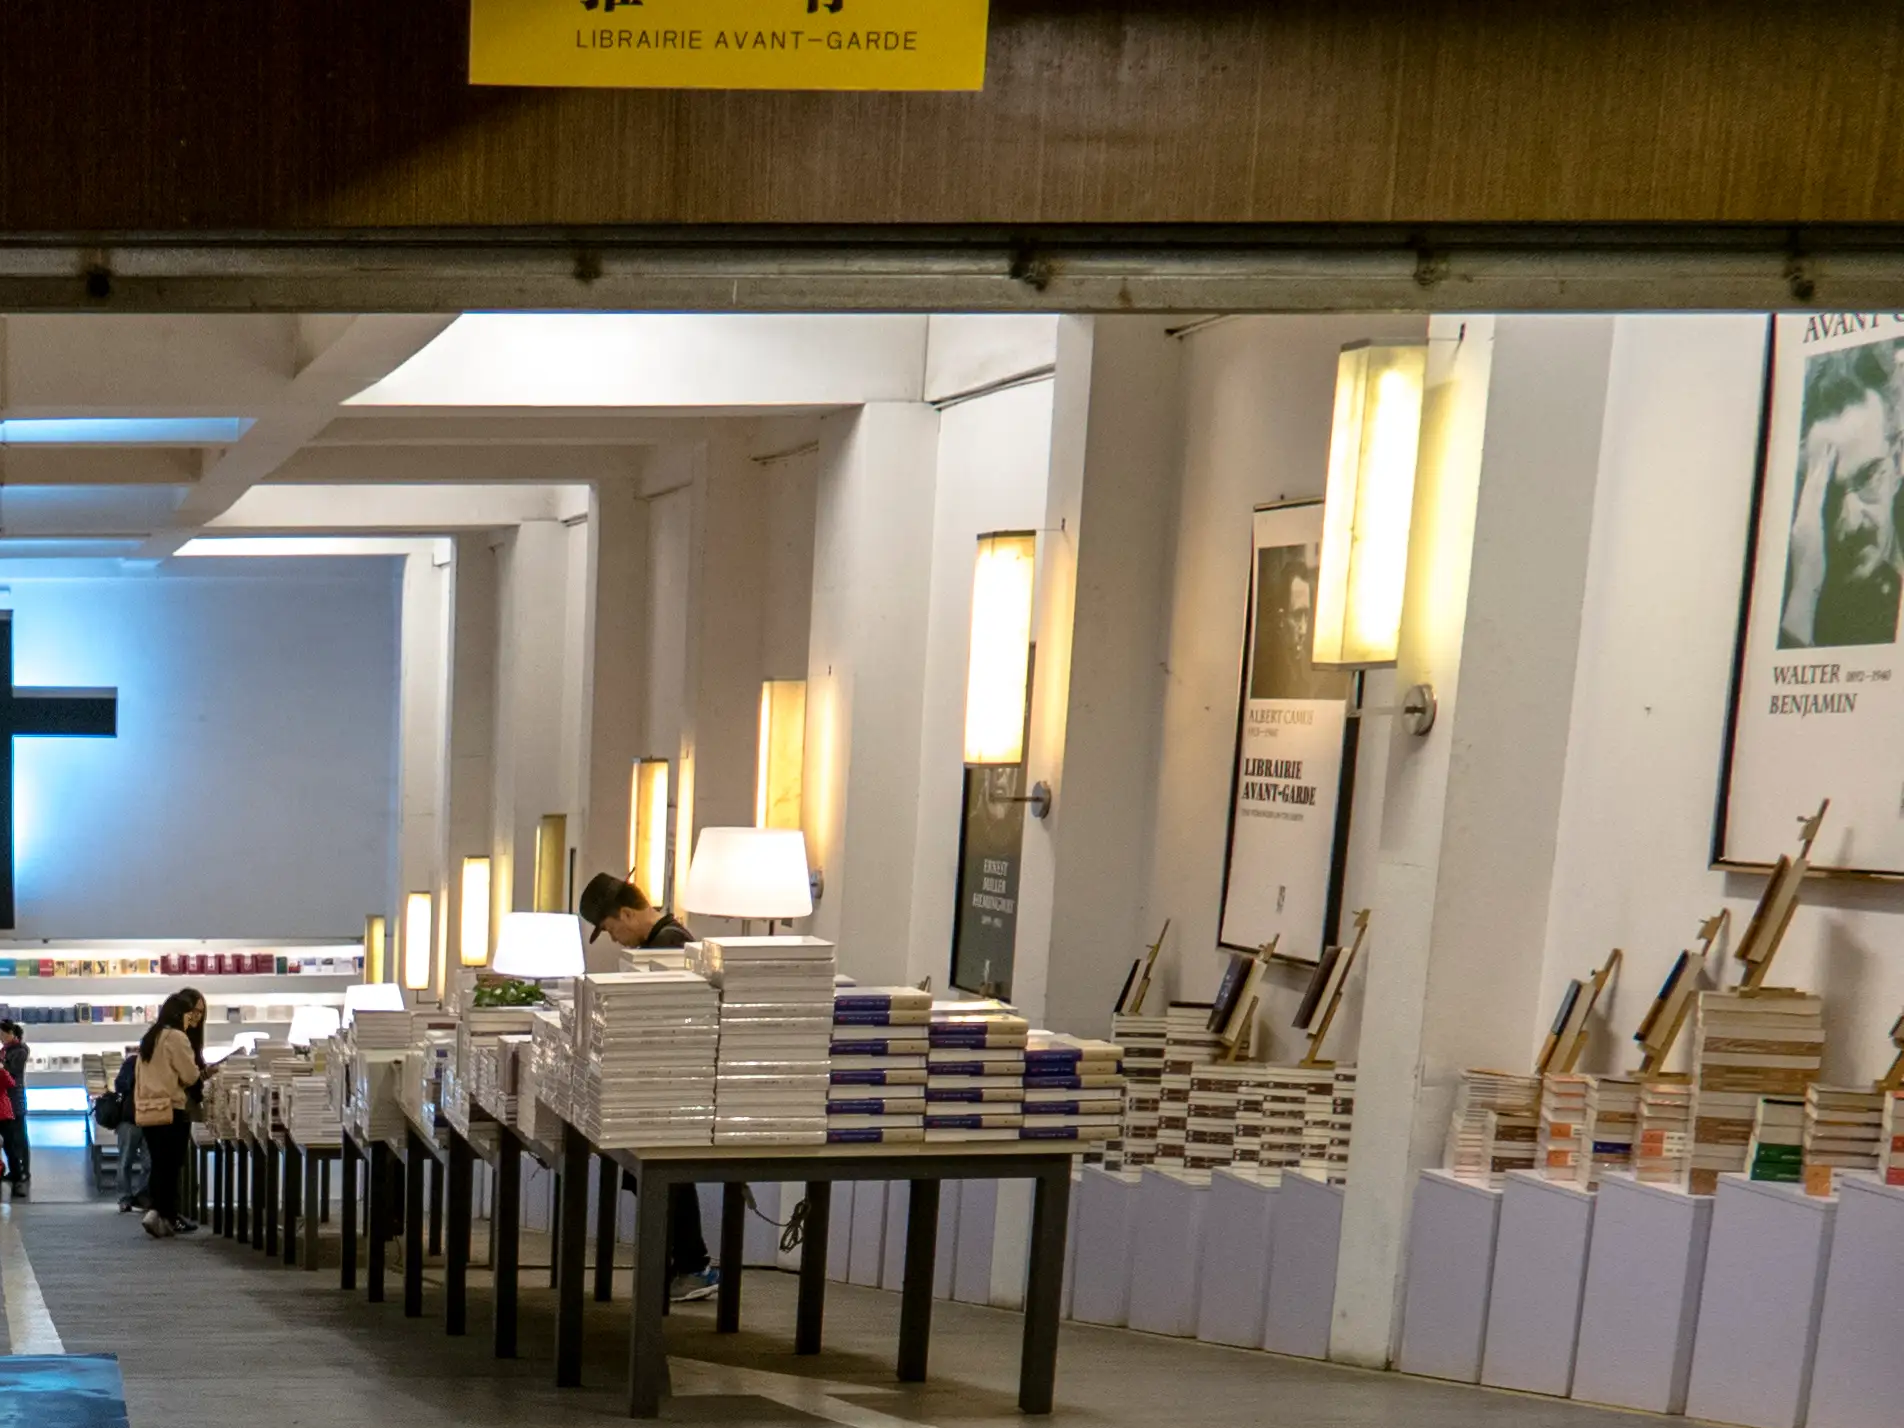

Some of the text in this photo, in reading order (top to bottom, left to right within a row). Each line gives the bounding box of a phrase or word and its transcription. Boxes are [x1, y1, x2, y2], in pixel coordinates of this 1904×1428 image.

[575, 29, 918, 51] LIBRAIRIE AVANT-GARDE
[1772, 663, 1841, 685] WALTER
[1768, 692, 1858, 718] BENJAMIN
[1249, 708, 1283, 725] ALBERT
[1244, 757, 1303, 780] LIBRAIRIE
[1242, 781, 1317, 806] AVANT-GARDE
